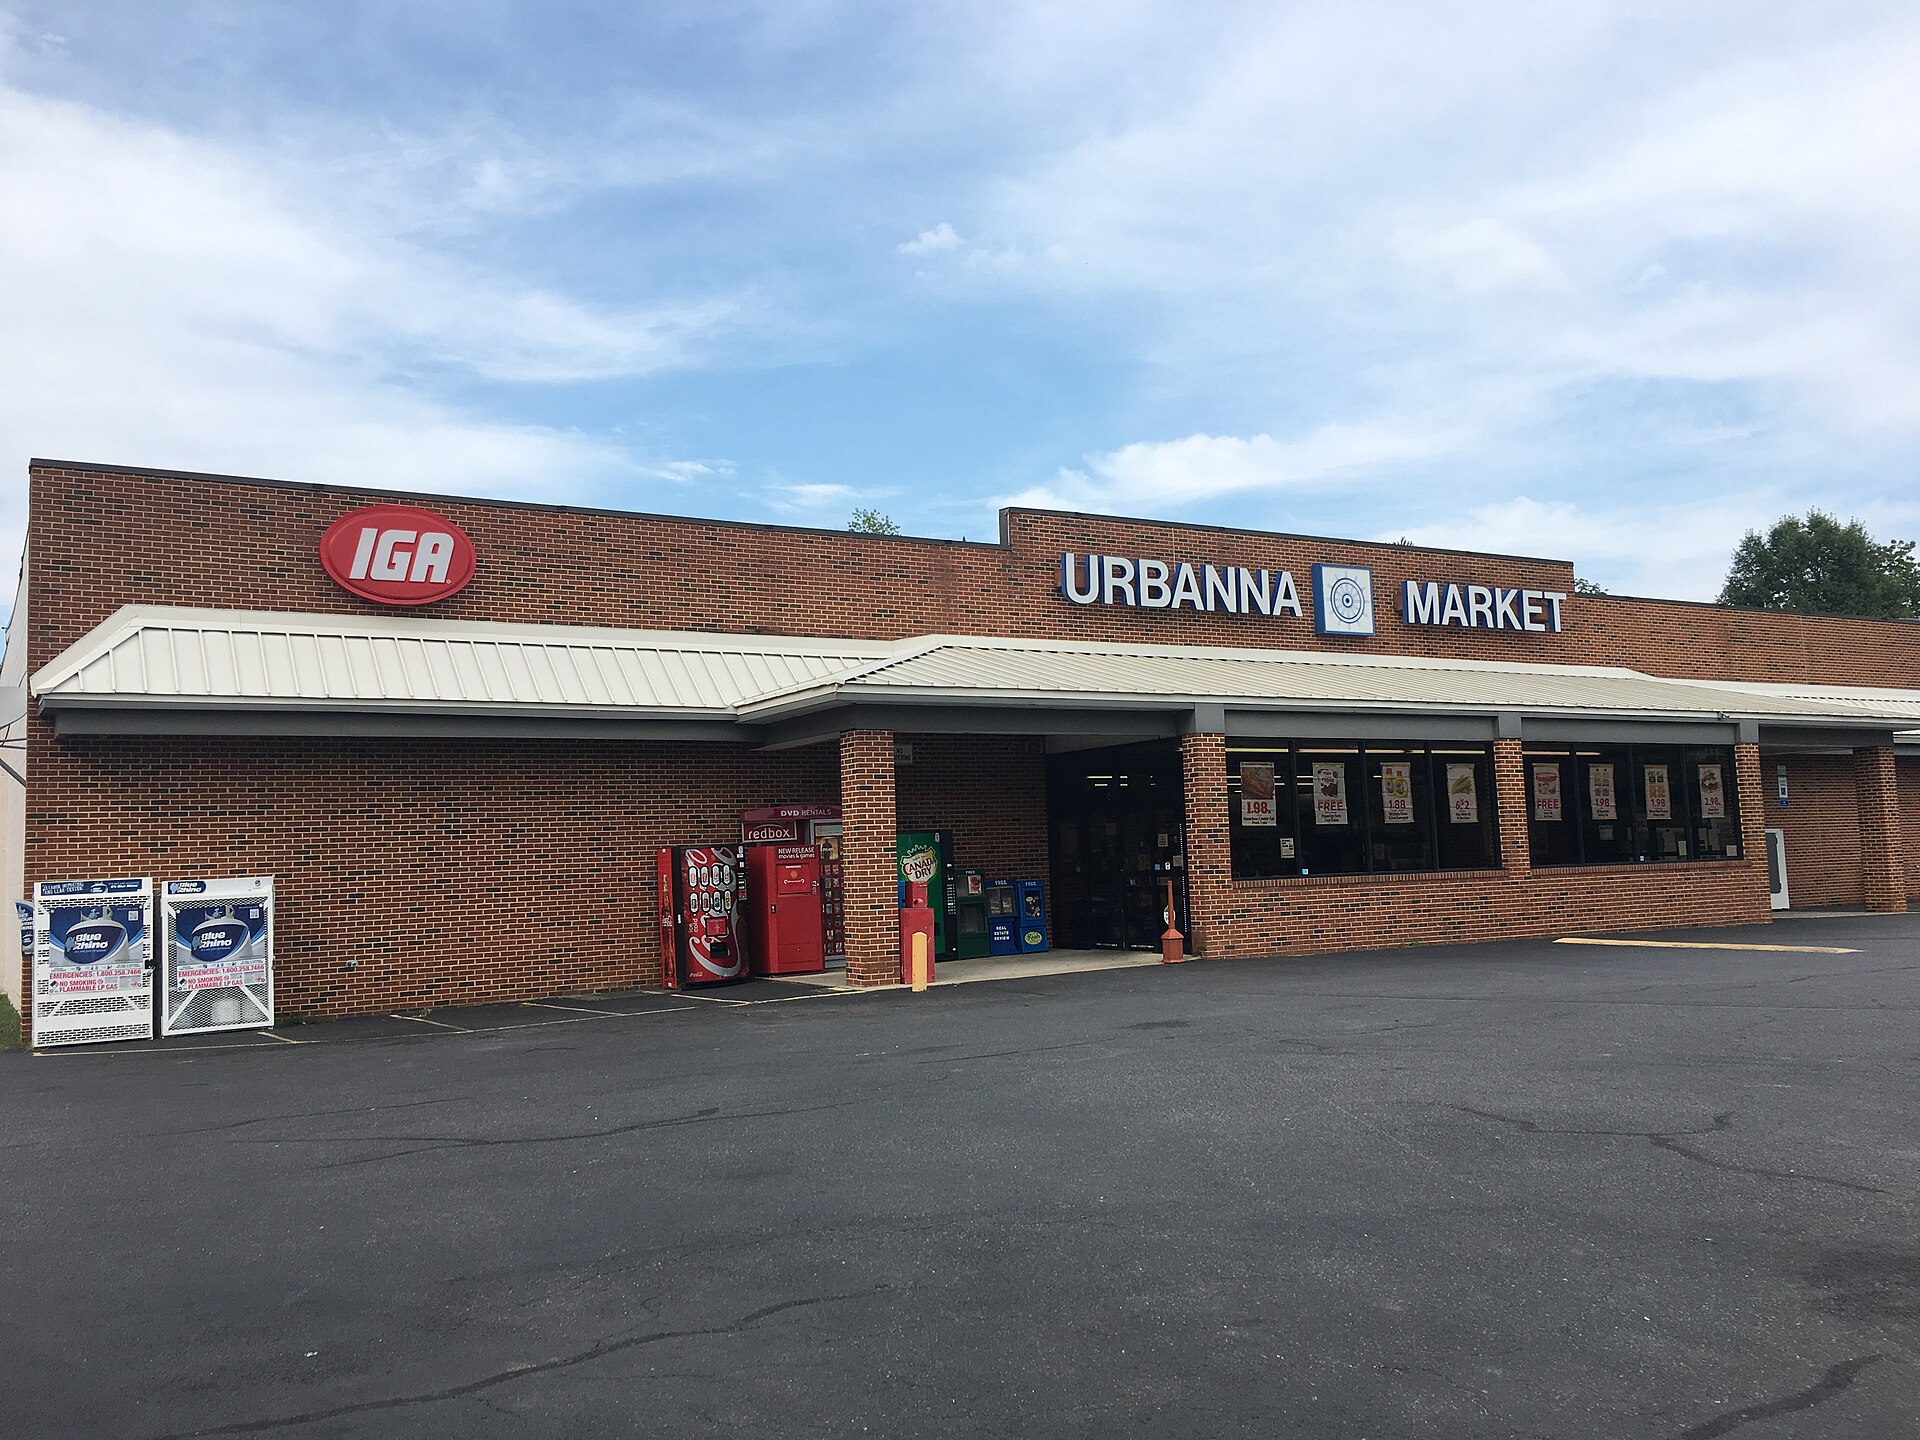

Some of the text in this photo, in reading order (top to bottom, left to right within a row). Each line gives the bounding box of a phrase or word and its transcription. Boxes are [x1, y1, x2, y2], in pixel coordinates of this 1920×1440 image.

[349, 528, 453, 583] IGA
[1061, 552, 1567, 633] URBANNA MARKET
[1318, 800, 1344, 811] FREE
[1389, 800, 1406, 809] 1.88
[1537, 800, 1559, 810] FREE
[1651, 798, 1666, 807] 1.98
[1704, 797, 1719, 806] 2.98
[1247, 801, 1267, 814] 1.98
[749, 827, 790, 840] redbox
[915, 866, 932, 879] DRY
[76, 933, 102, 942] Blue
[202, 931, 226, 940] Blue
[73, 941, 109, 950] Rhino
[199, 939, 233, 948] Rhino
[50, 972, 95, 980] EMERGENCIES:
[59, 985, 96, 993] FLAMMABLE
[188, 982, 223, 990] FLAMMABLE
